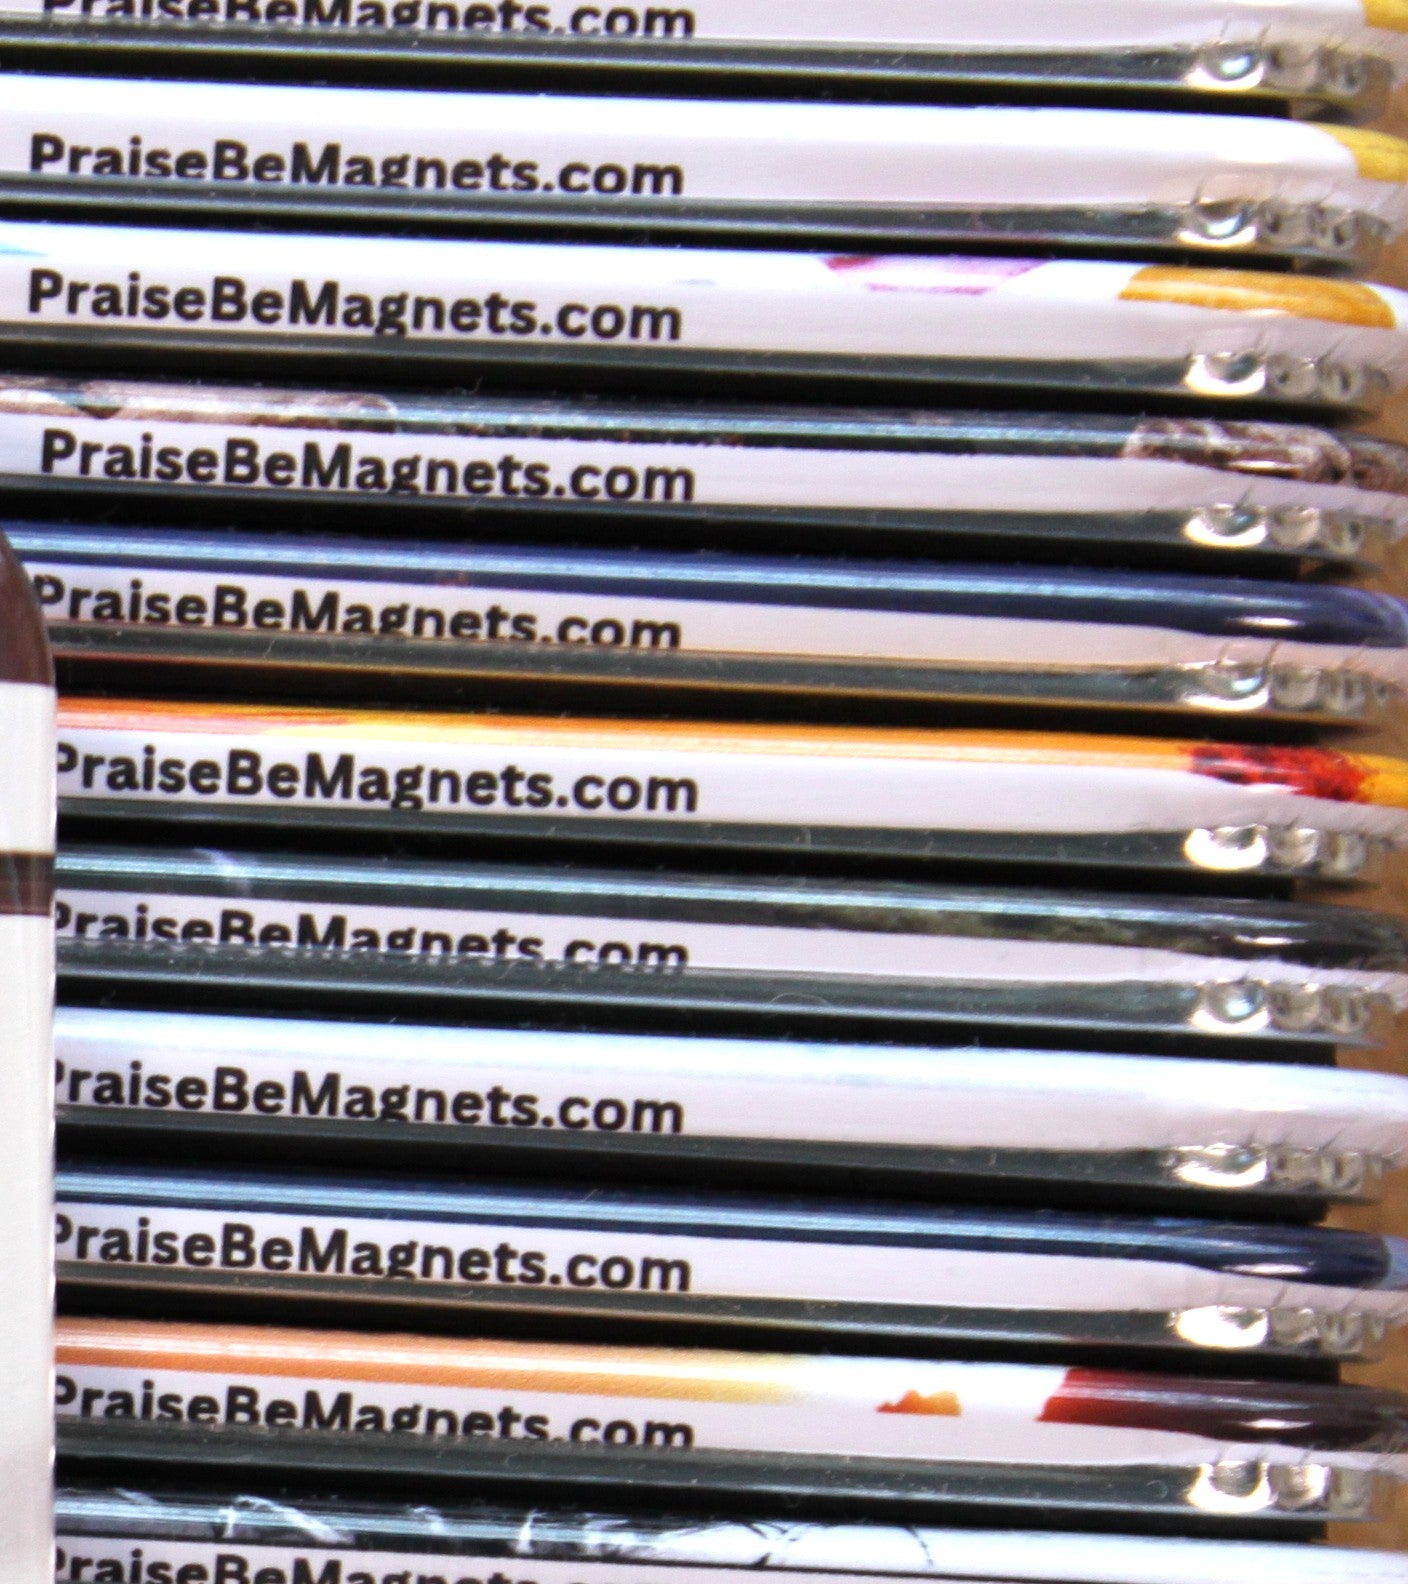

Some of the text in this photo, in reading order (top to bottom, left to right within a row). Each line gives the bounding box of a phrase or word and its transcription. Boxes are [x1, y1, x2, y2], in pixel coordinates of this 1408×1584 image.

[30, 134, 684, 195] PraiseBeMagnets.com
[28, 269, 681, 340] PraiseBeMagnets.com
[42, 429, 695, 501] PraiseBeMagnets.com
[32, 574, 681, 650] PraiseBeMagnets.com
[56, 742, 698, 812] PraiseBeMagnets.com
[55, 1058, 685, 1134] raiseBeMagnets.com
